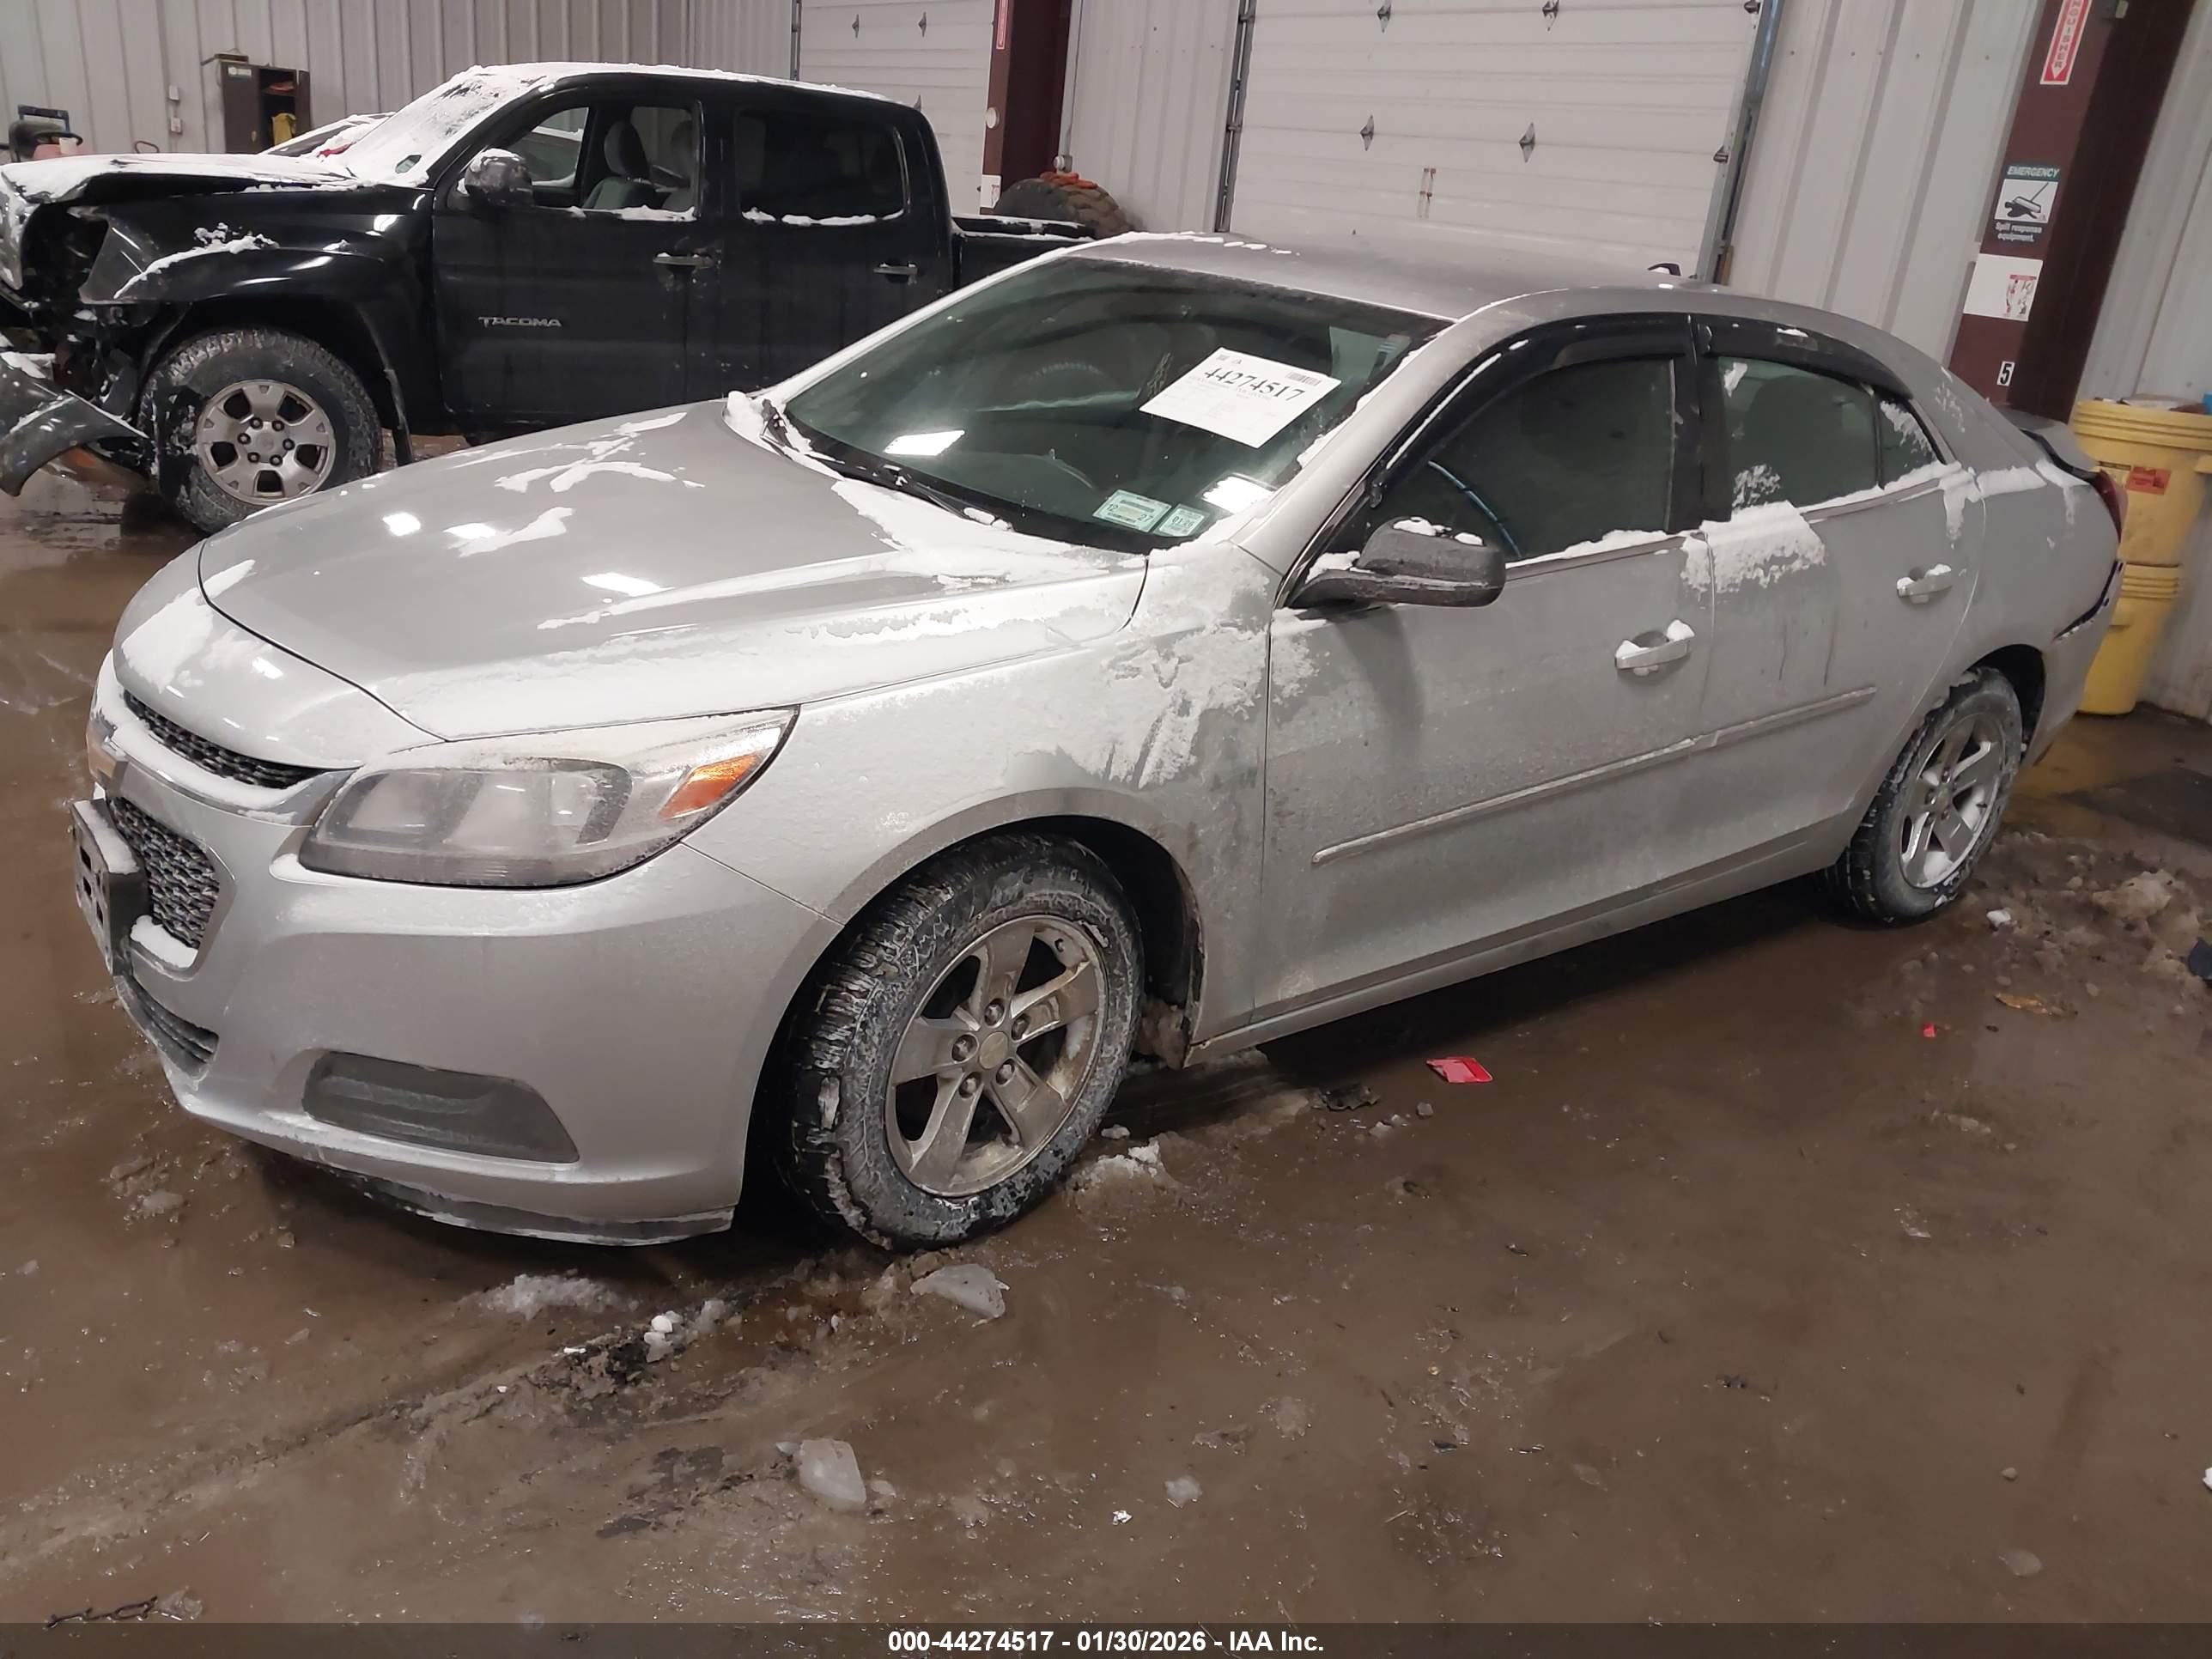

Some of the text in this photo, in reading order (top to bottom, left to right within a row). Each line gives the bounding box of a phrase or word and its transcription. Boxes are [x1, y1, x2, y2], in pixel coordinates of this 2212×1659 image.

[2007, 165, 2060, 178] EMERGENCY
[477, 317, 562, 328] TACOMA
[2000, 363, 2012, 385] 5
[1204, 367, 1306, 402] 44274517
[1106, 503, 1119, 513] 12
[1137, 514, 1153, 523] 27
